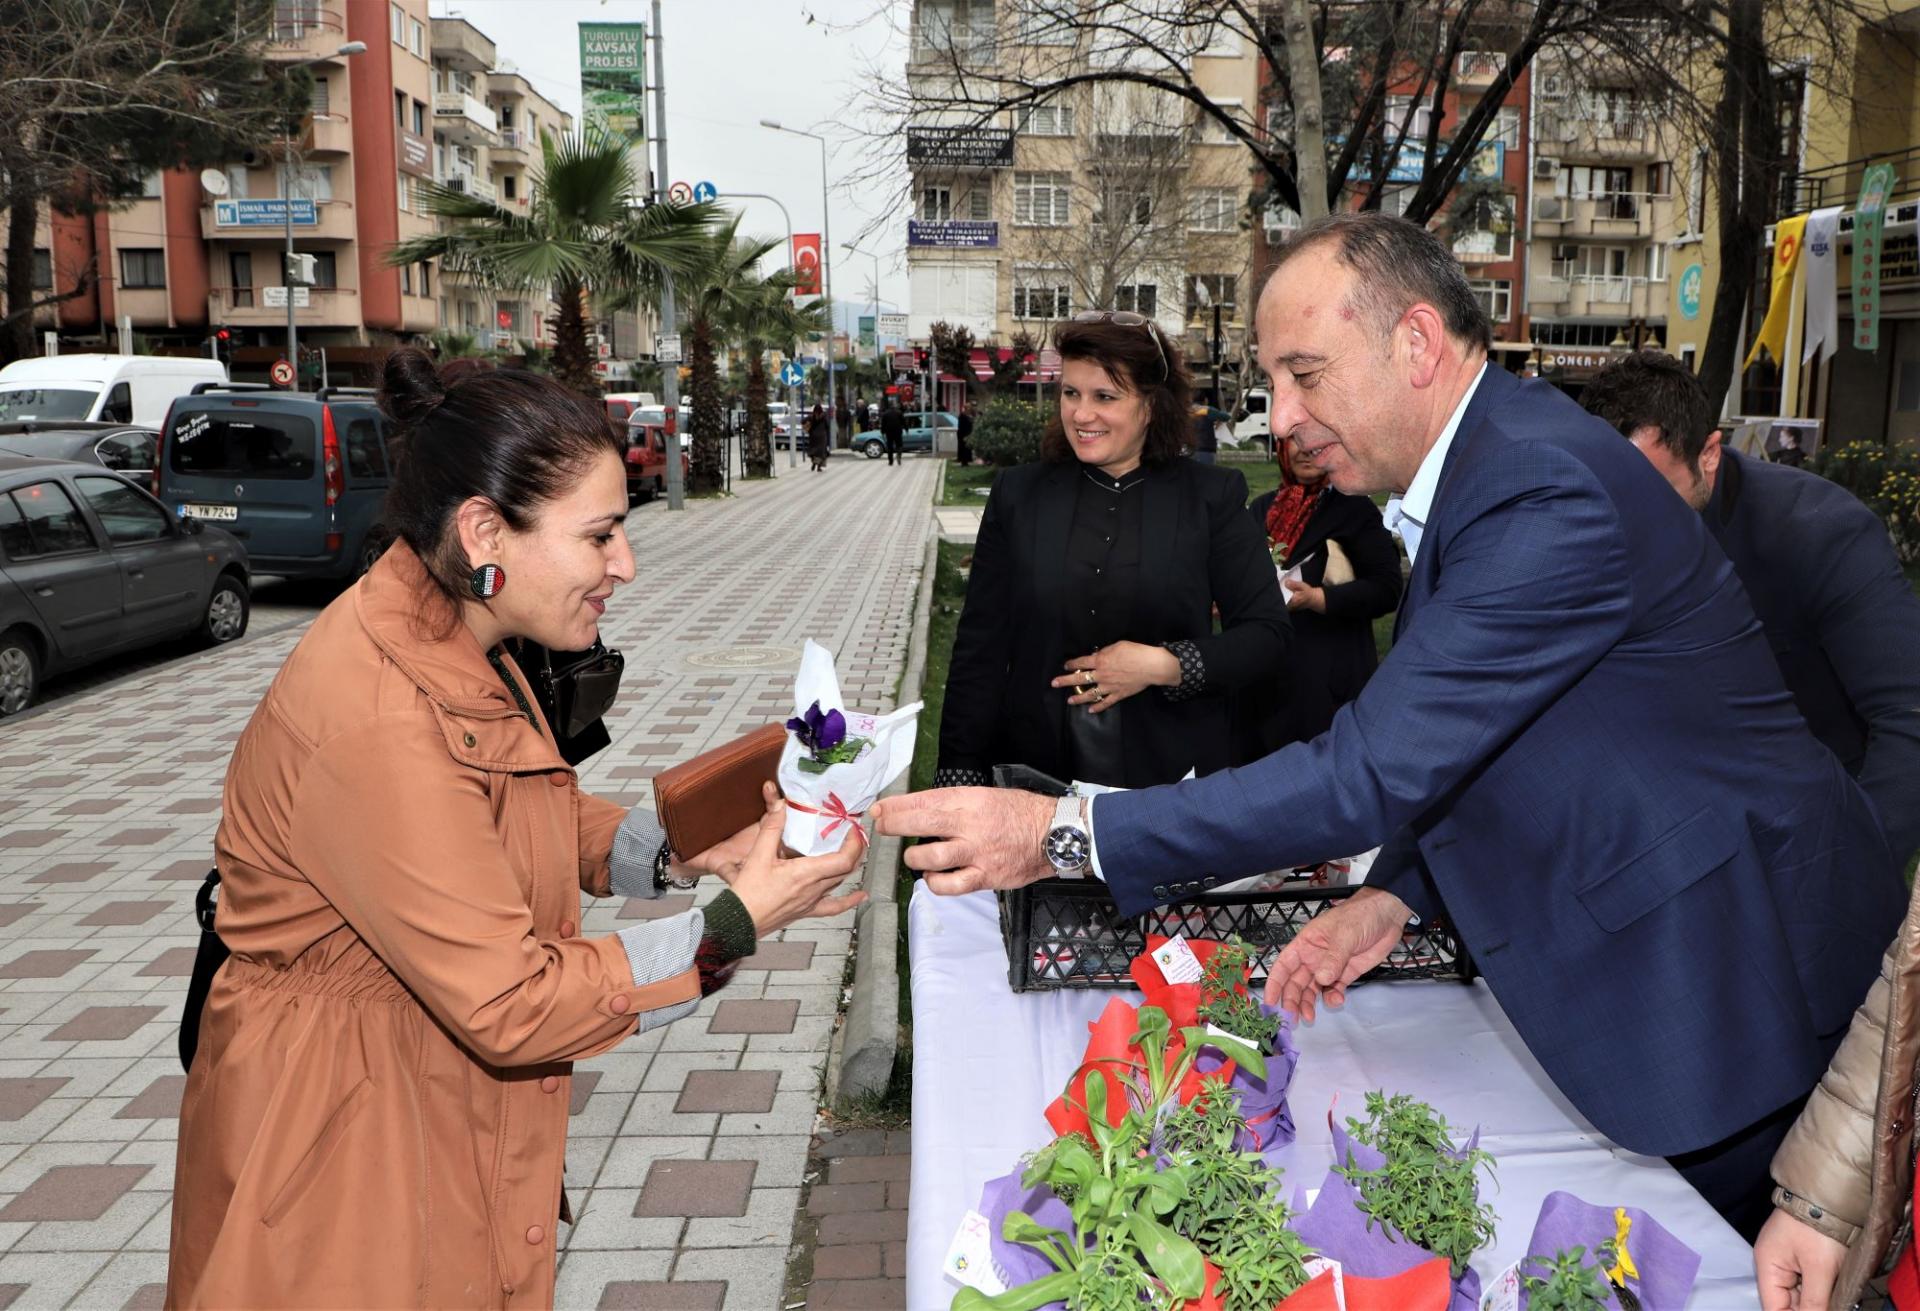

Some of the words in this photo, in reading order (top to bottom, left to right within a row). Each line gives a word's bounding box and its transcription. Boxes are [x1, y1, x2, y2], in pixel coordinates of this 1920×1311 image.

[584, 31, 639, 42] TURGUTLU
[585, 42, 637, 54] KAVŞAK
[585, 54, 638, 68] PROJESİ
[199, 506, 210, 517] YN
[212, 507, 235, 517] 7244
